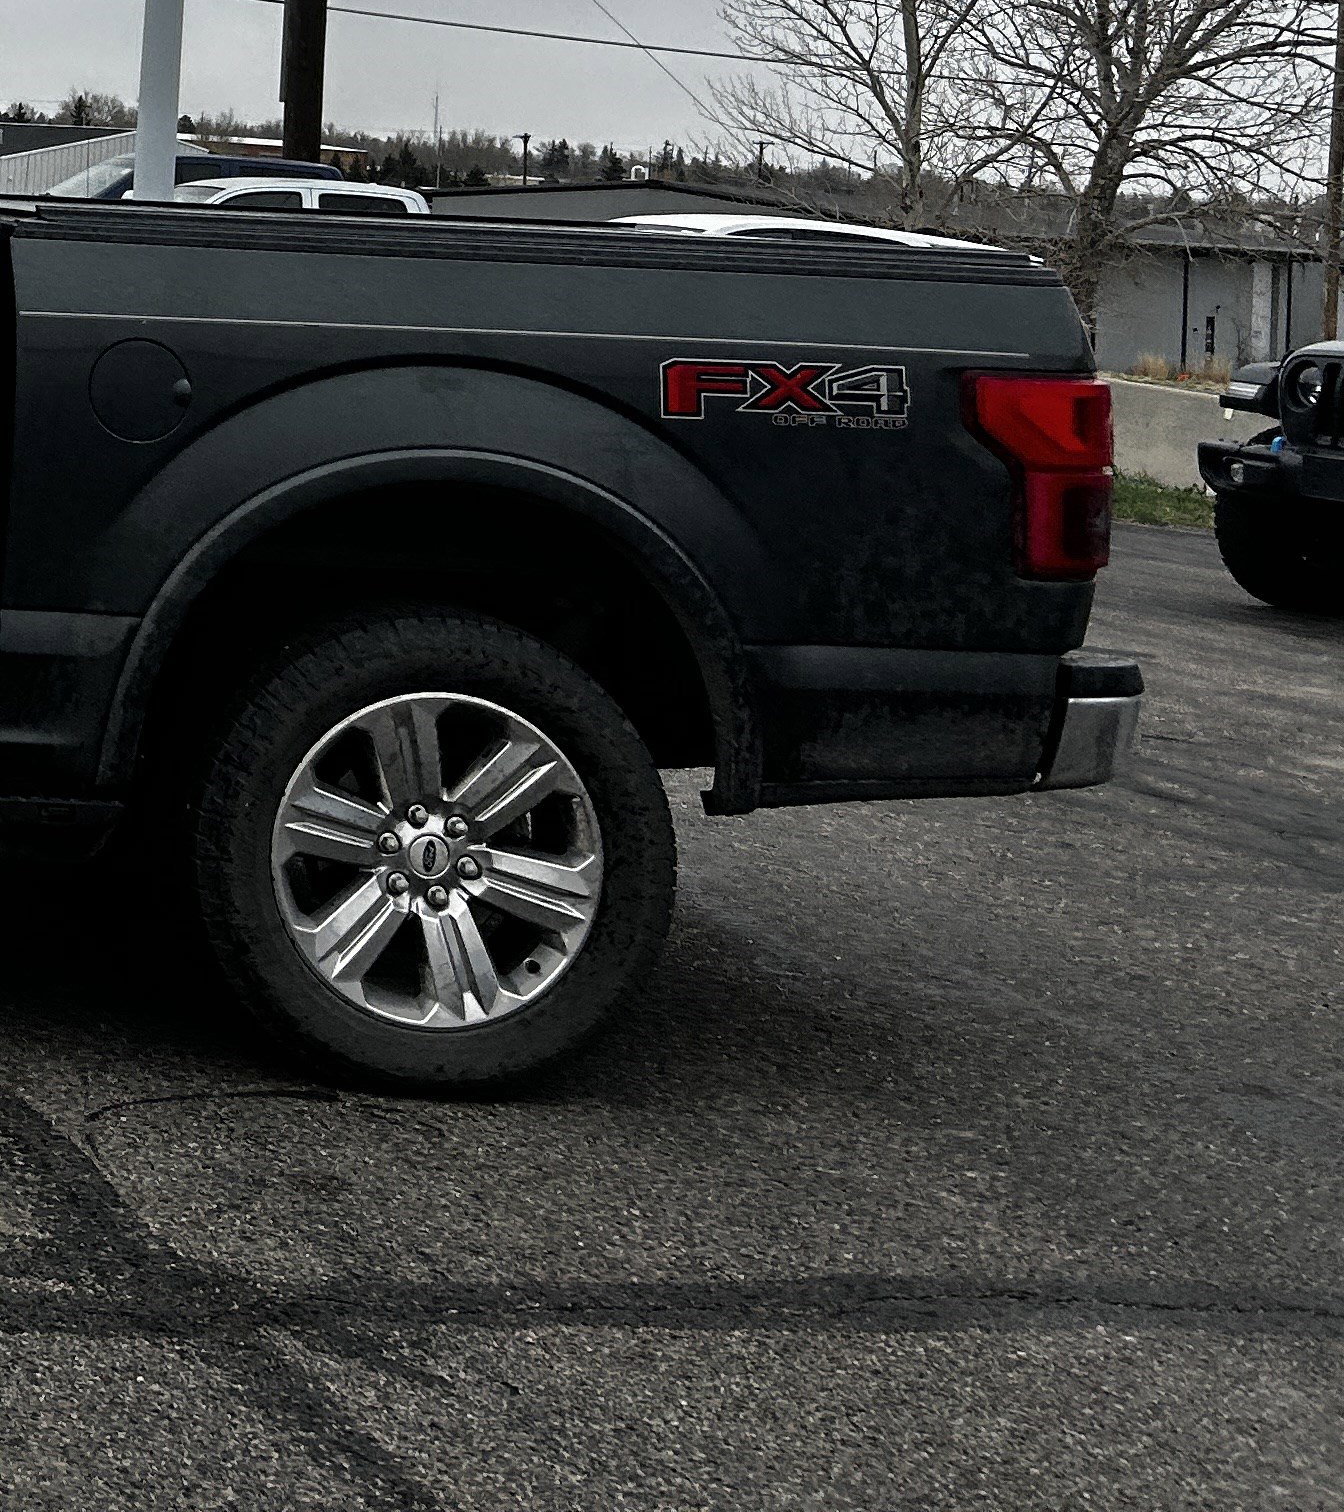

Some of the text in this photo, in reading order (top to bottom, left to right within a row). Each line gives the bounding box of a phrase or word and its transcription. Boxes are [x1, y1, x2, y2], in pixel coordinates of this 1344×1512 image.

[659, 357, 911, 420] FX4
[771, 413, 909, 430] OFF ROAD
